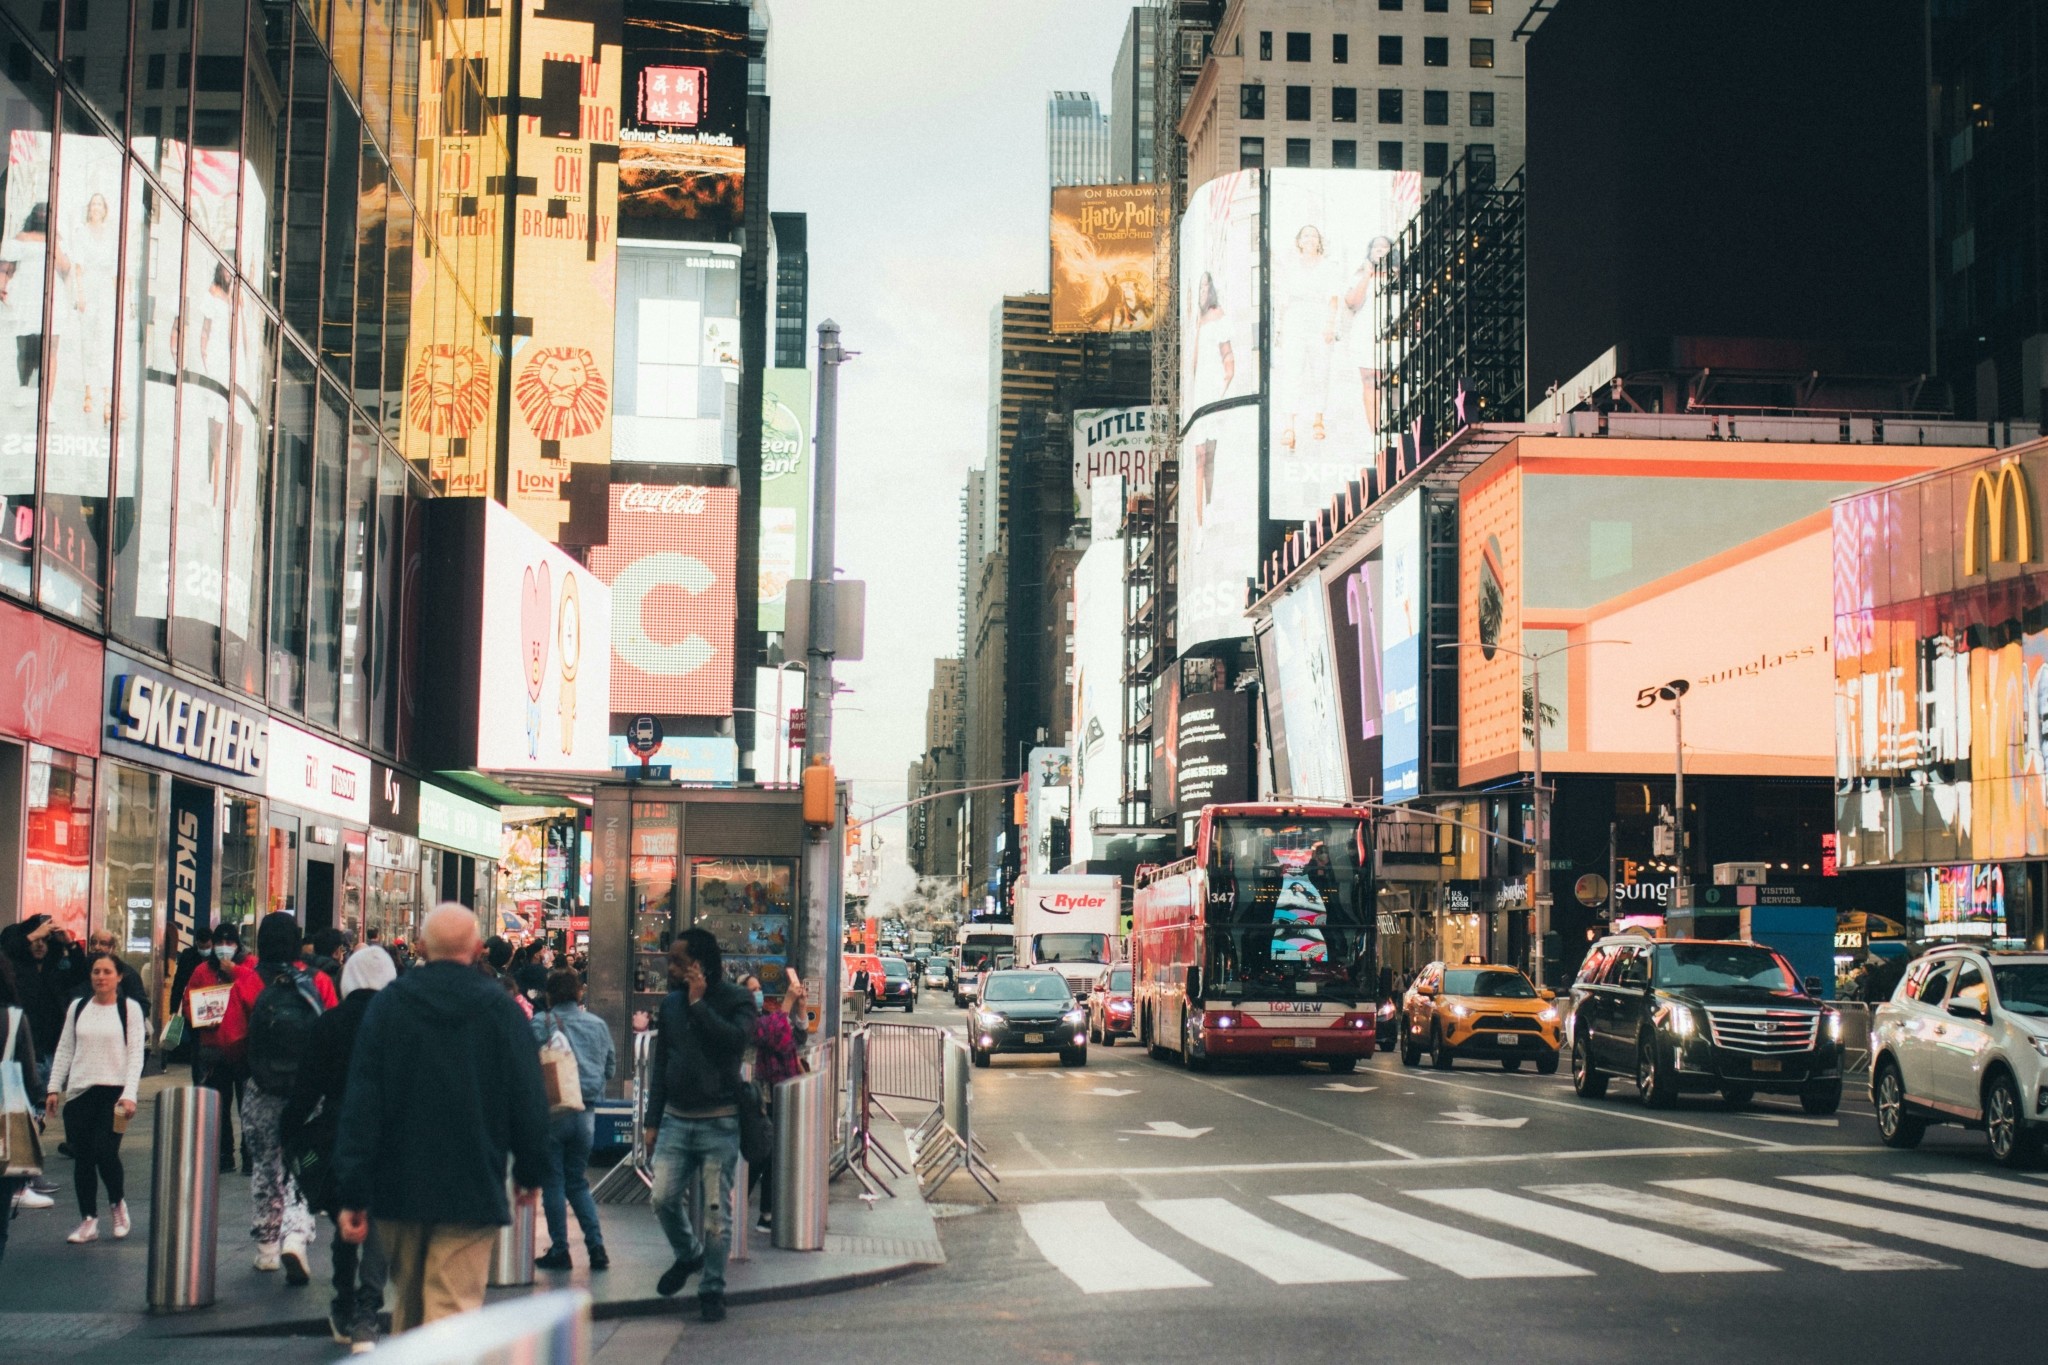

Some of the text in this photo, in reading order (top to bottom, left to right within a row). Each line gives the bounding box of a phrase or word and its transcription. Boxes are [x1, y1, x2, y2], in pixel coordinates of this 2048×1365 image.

[657, 130, 697, 145] Screen
[698, 131, 734, 147] Media
[554, 155, 582, 194] ON
[522, 208, 611, 243] BROADWY
[1080, 205, 1125, 235] Harry
[685, 257, 736, 270] SAMSUNG
[1087, 411, 1146, 447] LITTLE
[517, 469, 554, 493] LION
[1303, 414, 1422, 559] BROADWAY
[620, 483, 709, 515] Coca-Cola
[1698, 646, 1814, 687] sunglass
[124, 674, 269, 778] SKECHERS
[650, 766, 662, 777] M7
[919, 786, 927, 847] WELINGTON
[603, 817, 619, 903] Newsstand
[1055, 893, 1106, 912] Ryder
[1211, 892, 1235, 903] 347
[1760, 887, 1796, 896] VISITOR
[1760, 896, 1802, 905] SERVICES
